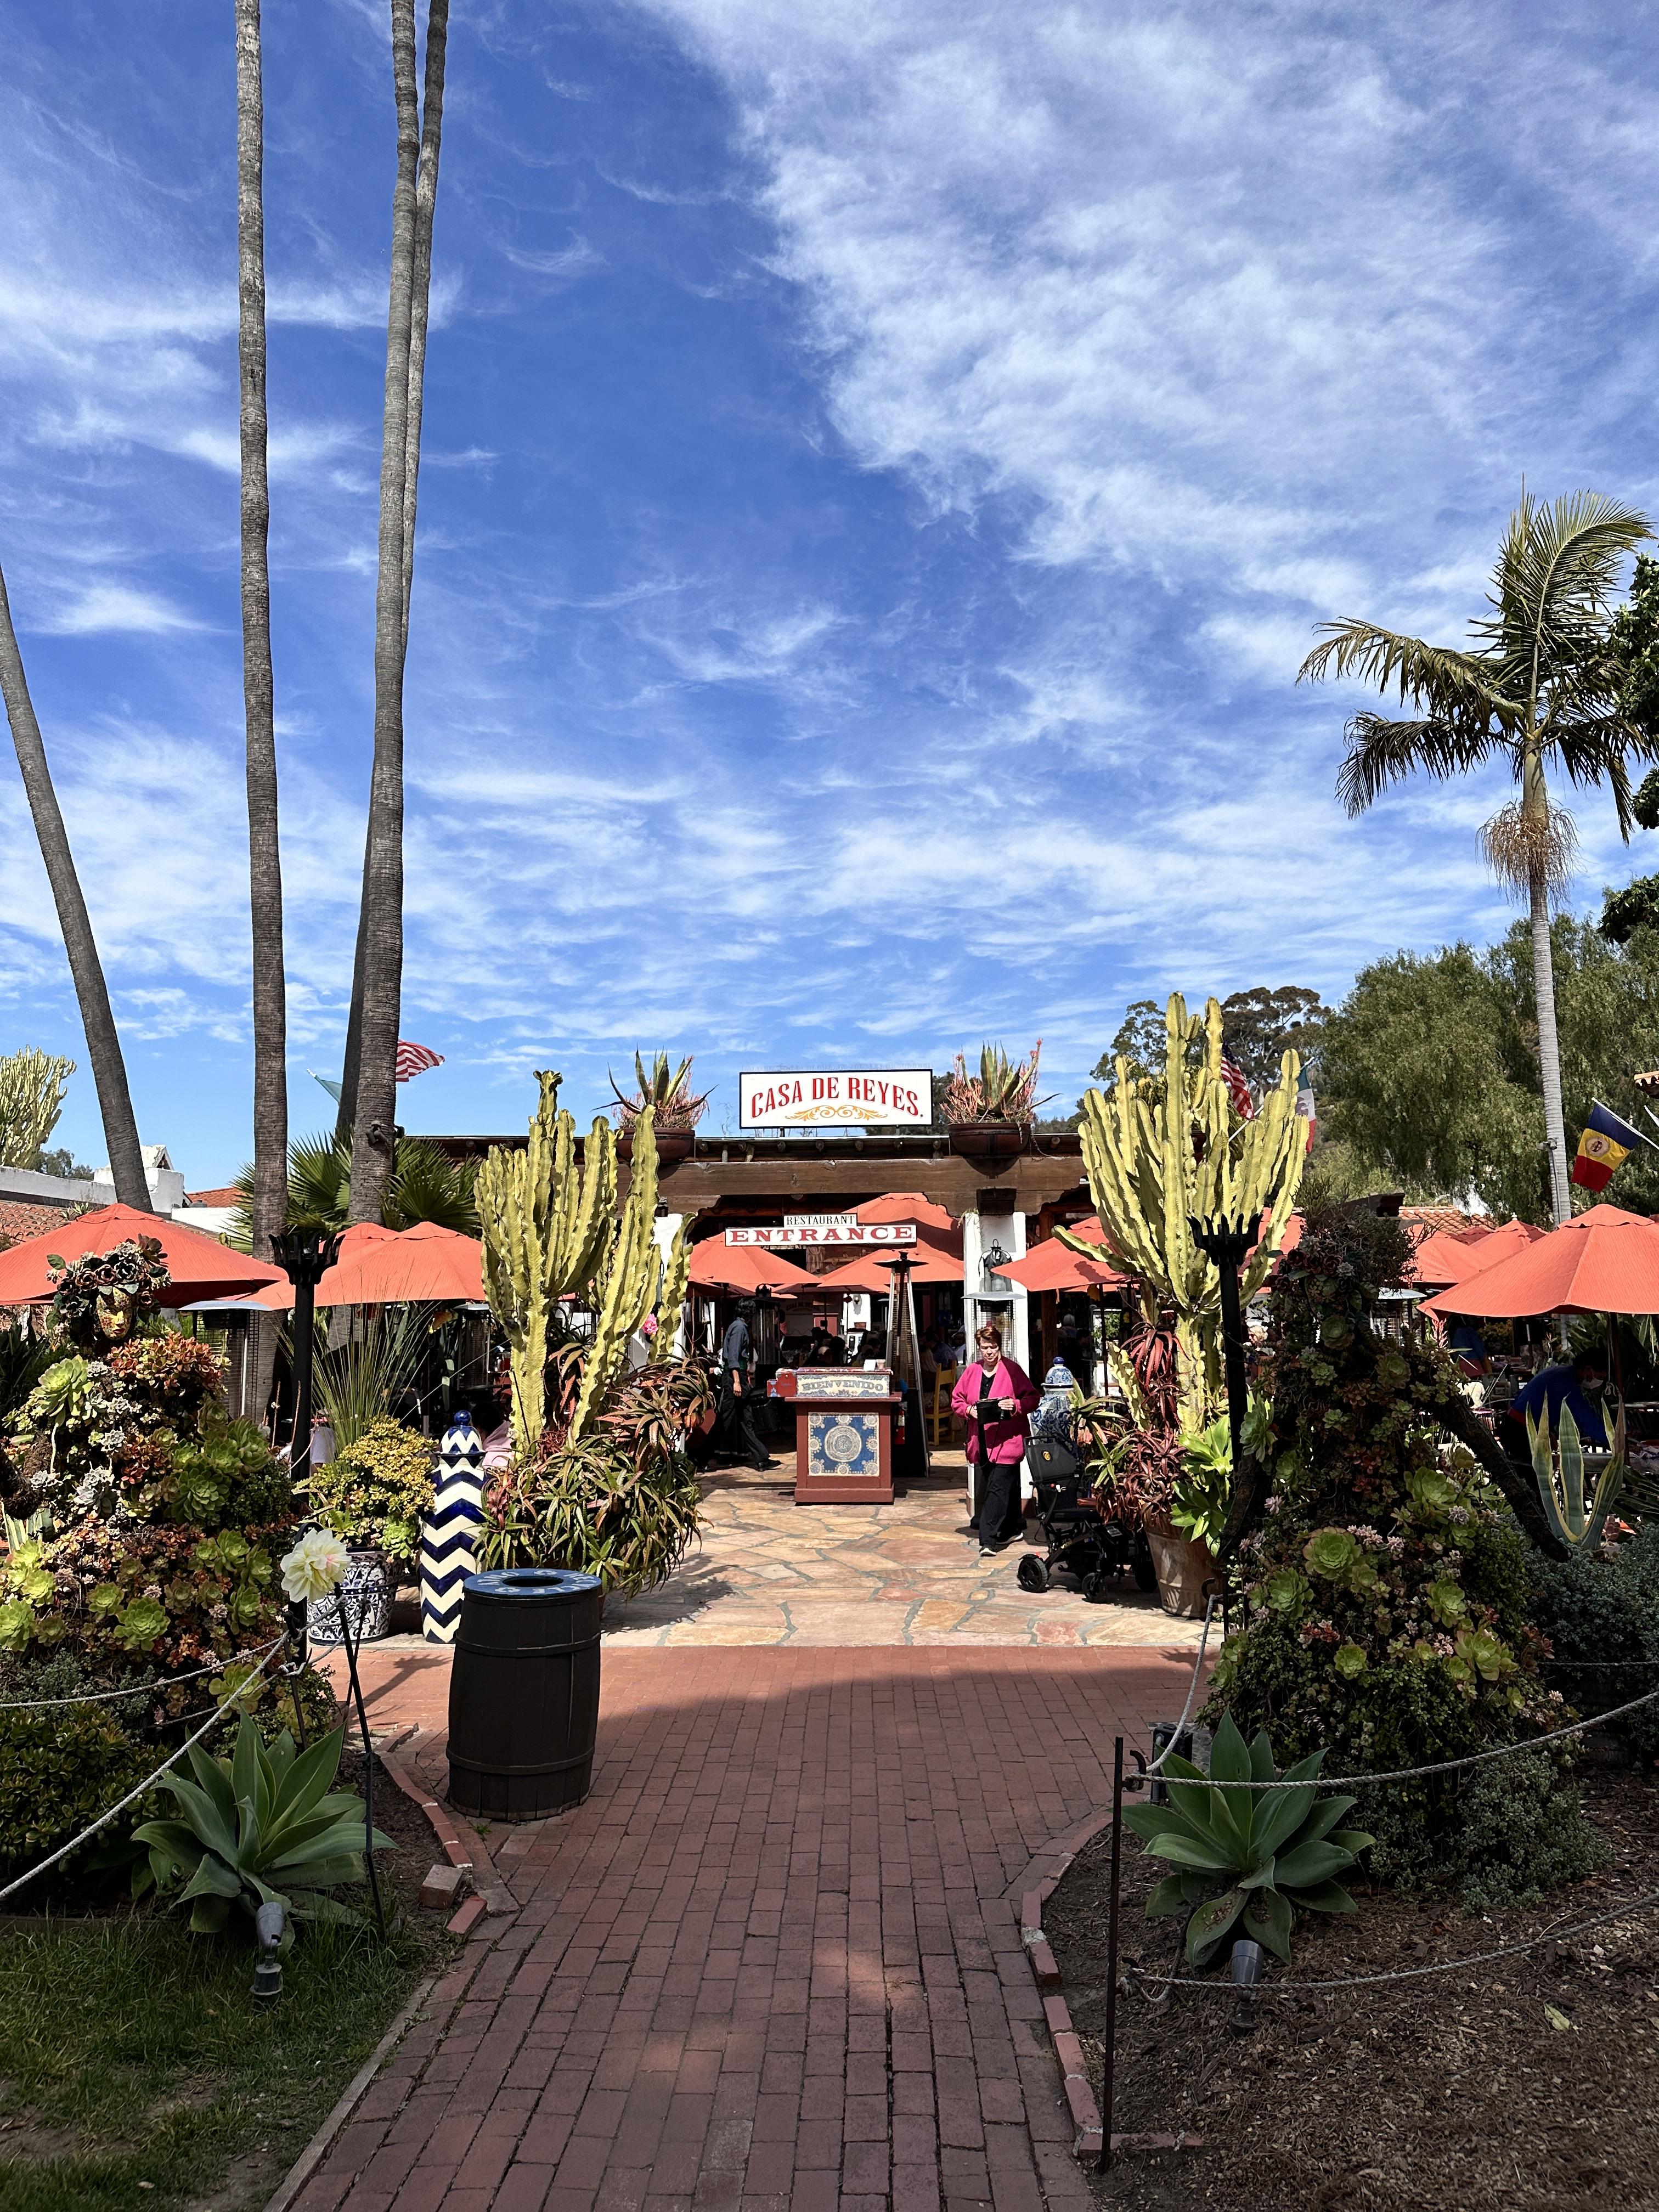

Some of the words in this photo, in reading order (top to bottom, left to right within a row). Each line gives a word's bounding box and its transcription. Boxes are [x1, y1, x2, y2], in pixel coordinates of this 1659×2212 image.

[751, 1080, 803, 1119] CASA
[811, 1077, 839, 1100] DE
[787, 1215, 855, 1224] RESTAURANT
[729, 1227, 912, 1243] ENTRANCE
[802, 1380, 883, 1391] BIENVENIDO
[532, 1573, 597, 1594] RECYCLE
